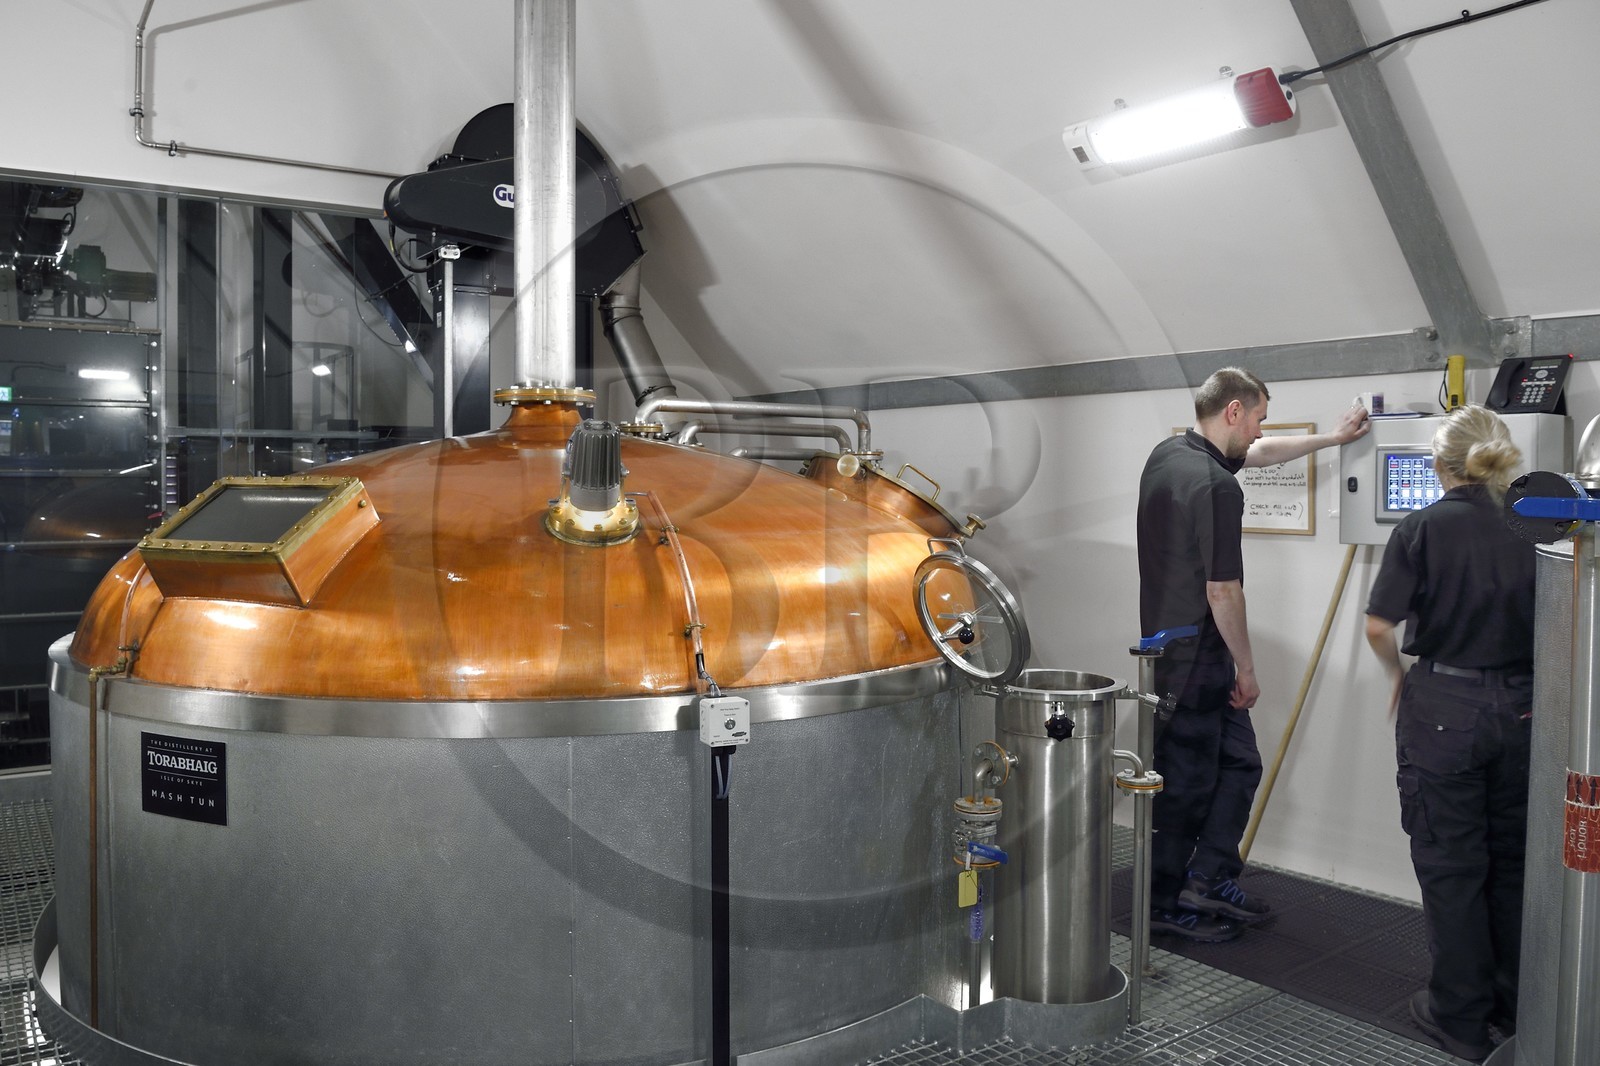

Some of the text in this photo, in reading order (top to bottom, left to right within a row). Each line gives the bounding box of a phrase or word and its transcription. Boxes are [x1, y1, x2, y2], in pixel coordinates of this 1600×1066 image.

[164, 742, 203, 752] DISTILLERY
[147, 750, 218, 774] TORABHAIG
[187, 779, 203, 787] SKYE
[151, 789, 215, 807] MASH TUN
